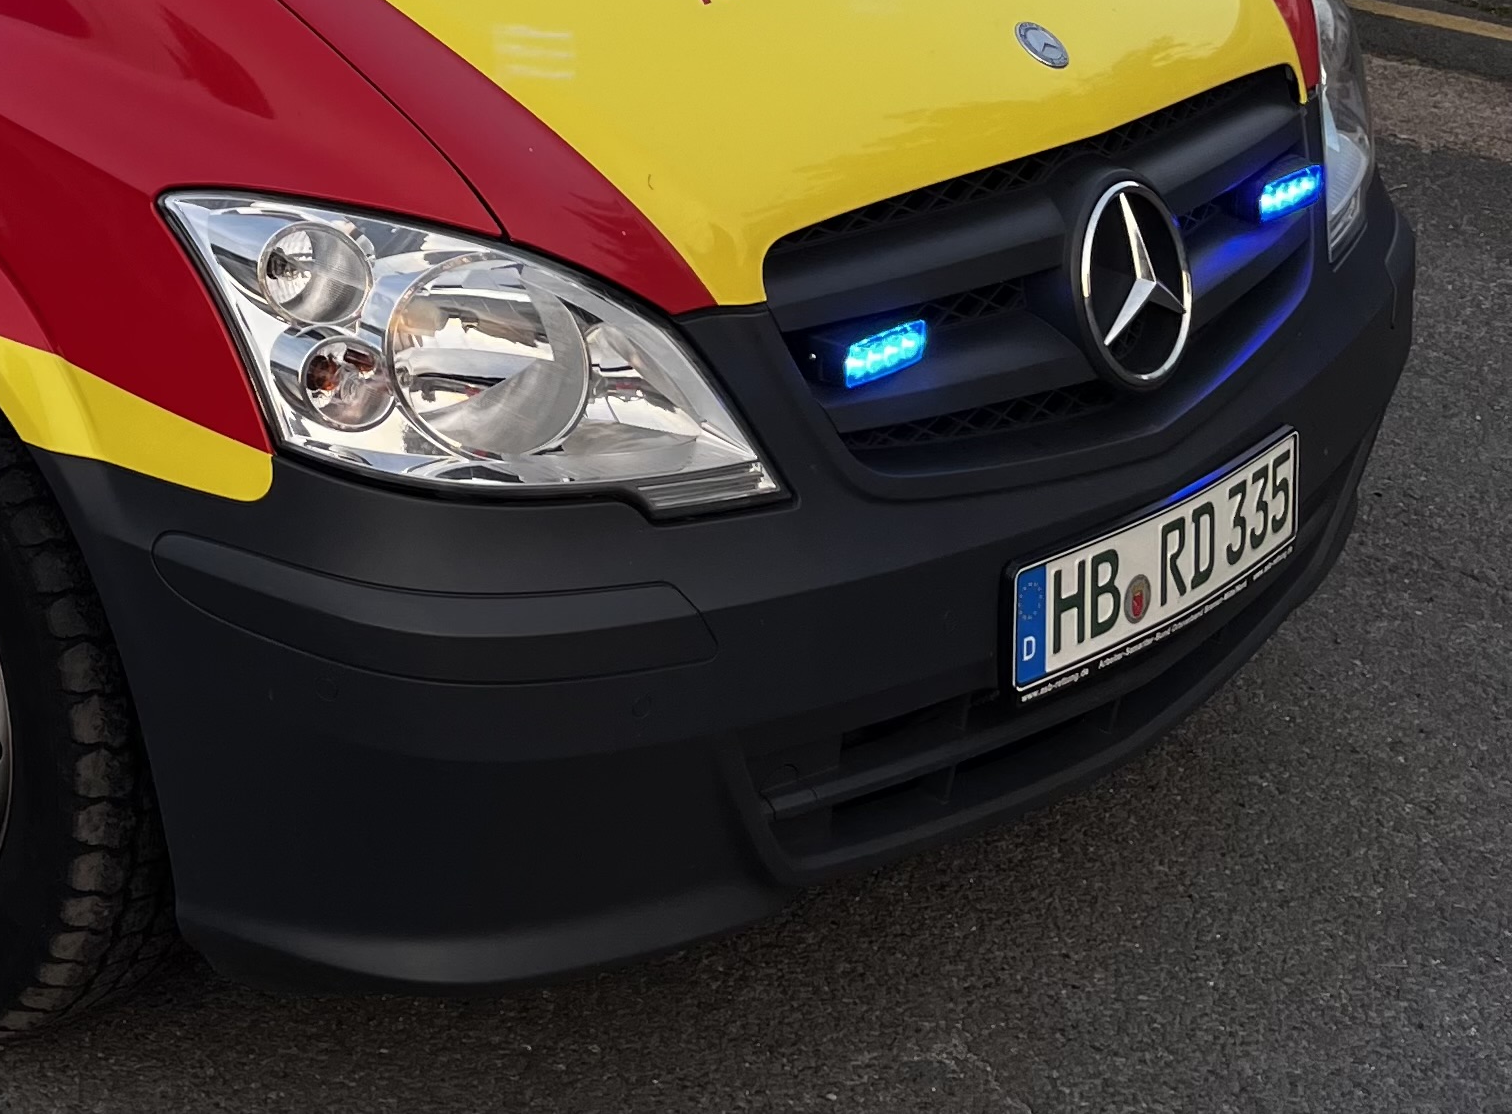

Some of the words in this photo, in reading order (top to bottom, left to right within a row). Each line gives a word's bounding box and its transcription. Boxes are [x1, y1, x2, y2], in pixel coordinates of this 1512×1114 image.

[1053, 548, 1121, 655] HB
[1160, 501, 1216, 608] RD
[1226, 448, 1291, 566] 335
[1022, 635, 1037, 662] D
